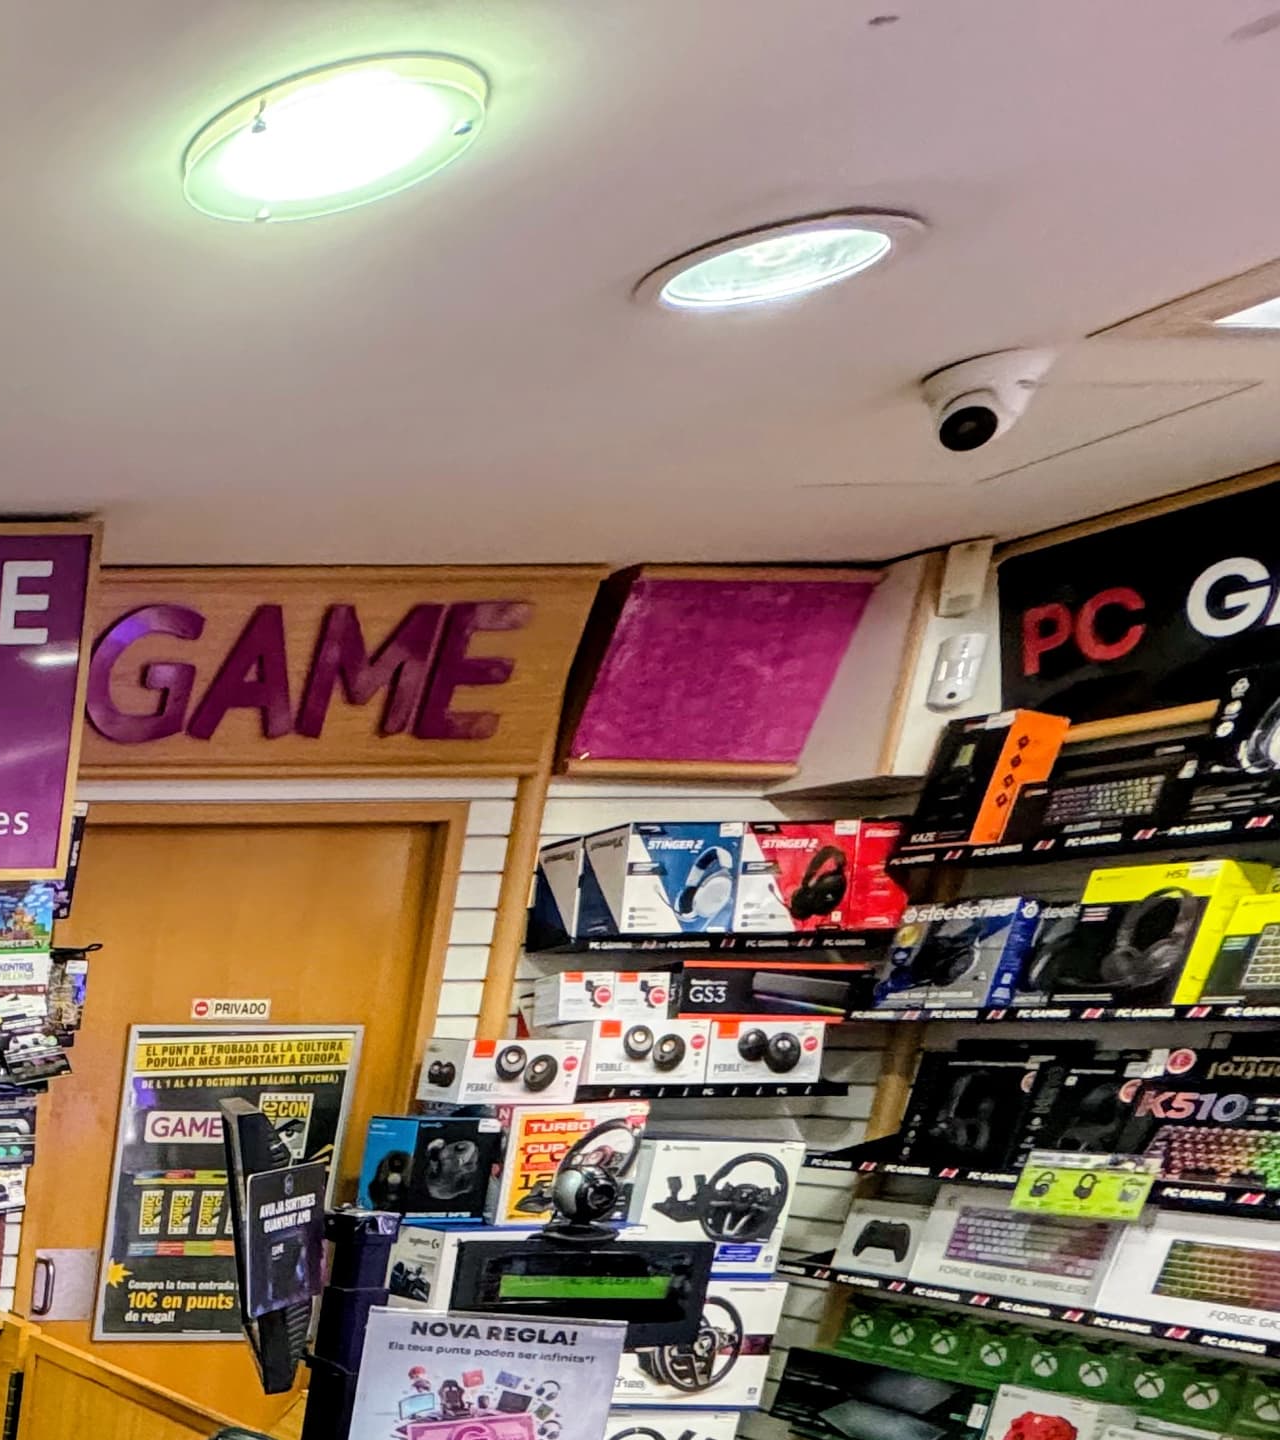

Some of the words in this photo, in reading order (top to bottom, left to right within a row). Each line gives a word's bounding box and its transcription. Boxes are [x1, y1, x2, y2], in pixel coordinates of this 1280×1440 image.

[1021, 588, 1145, 675] PC
[87, 602, 535, 744] GAME
[689, 985, 726, 1003] GS3
[214, 1002, 267, 1016] PRIVADO
[146, 1046, 159, 1056] EL
[162, 1045, 190, 1055] PUNT
[193, 1045, 207, 1055] DE
[212, 1044, 258, 1054] TROBADA
[263, 1043, 278, 1053] DE
[281, 1043, 292, 1052] LA
[297, 1042, 343, 1052] CULTURA
[147, 1057, 195, 1067] POPULAR
[200, 1054, 222, 1065] MÉS
[225, 1054, 286, 1065] IMPORTANT
[290, 1054, 296, 1063] A
[300, 1052, 341, 1063] EUROPA
[278, 1101, 309, 1117] CON
[151, 1117, 223, 1138] GAME
[531, 1120, 593, 1134] TURBO
[526, 1143, 568, 1155] CUP
[128, 1294, 158, 1309] 10€
[162, 1296, 182, 1308] en
[186, 1294, 234, 1310] punts
[410, 1321, 482, 1341] NOVA
[487, 1327, 578, 1346] REGLA!
